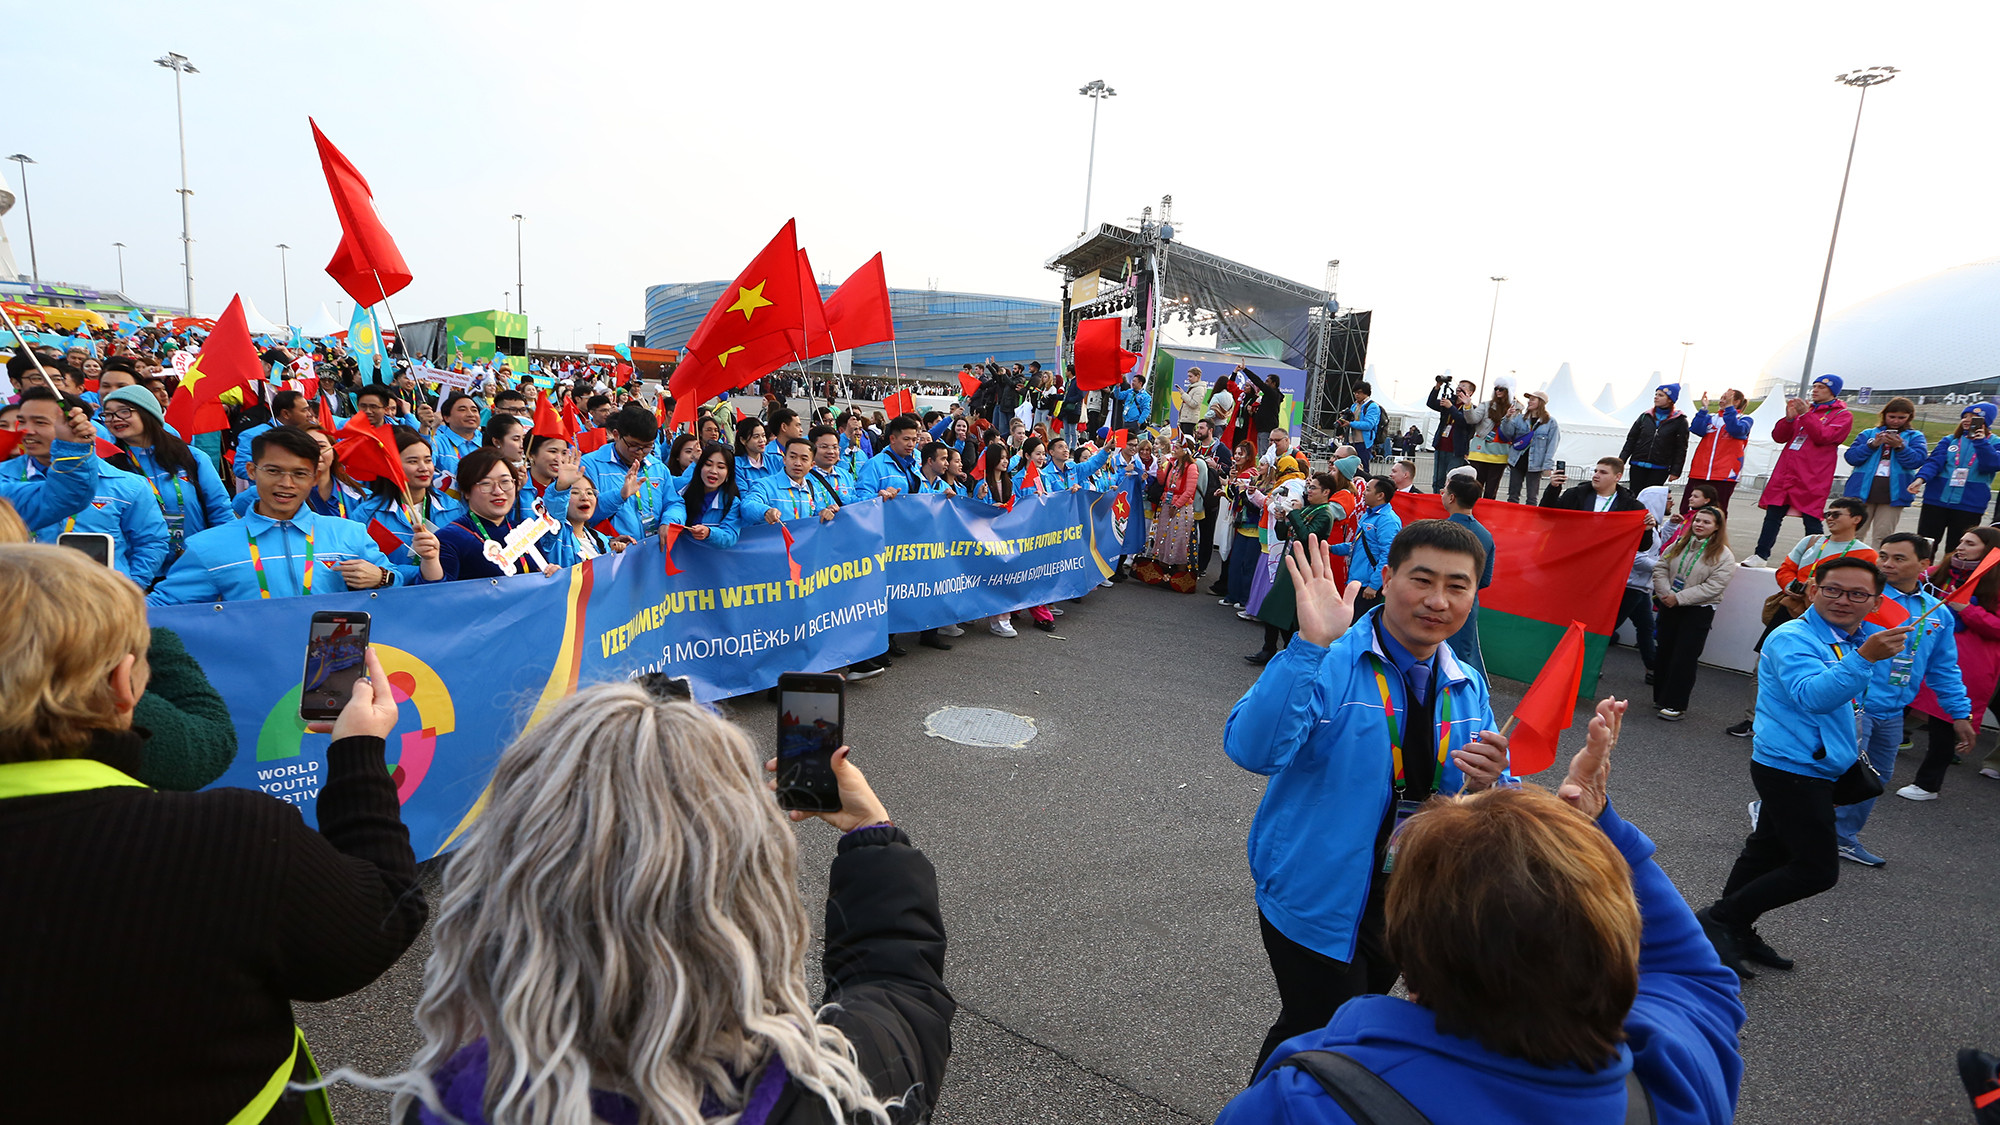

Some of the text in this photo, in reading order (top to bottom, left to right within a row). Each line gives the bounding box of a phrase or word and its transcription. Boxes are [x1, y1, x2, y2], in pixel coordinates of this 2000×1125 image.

[664, 589, 715, 616] OUTH
[719, 582, 782, 609] WITH
[785, 574, 816, 600] THE
[815, 557, 873, 590] WORLD
[950, 541, 983, 556] LET'S
[984, 539, 1015, 556] START
[1016, 537, 1035, 553] THE
[1034, 530, 1063, 550] FUTURE
[676, 629, 790, 662] МОЛОДЁЖЬ
[794, 623, 805, 642] И
[809, 597, 888, 638] ВСЕМИРНЫ
[885, 582, 931, 600] ТИВАЛЬ
[257, 761, 319, 780] WORLD
[259, 775, 317, 793] YOUTH
[275, 788, 319, 804] STIV
